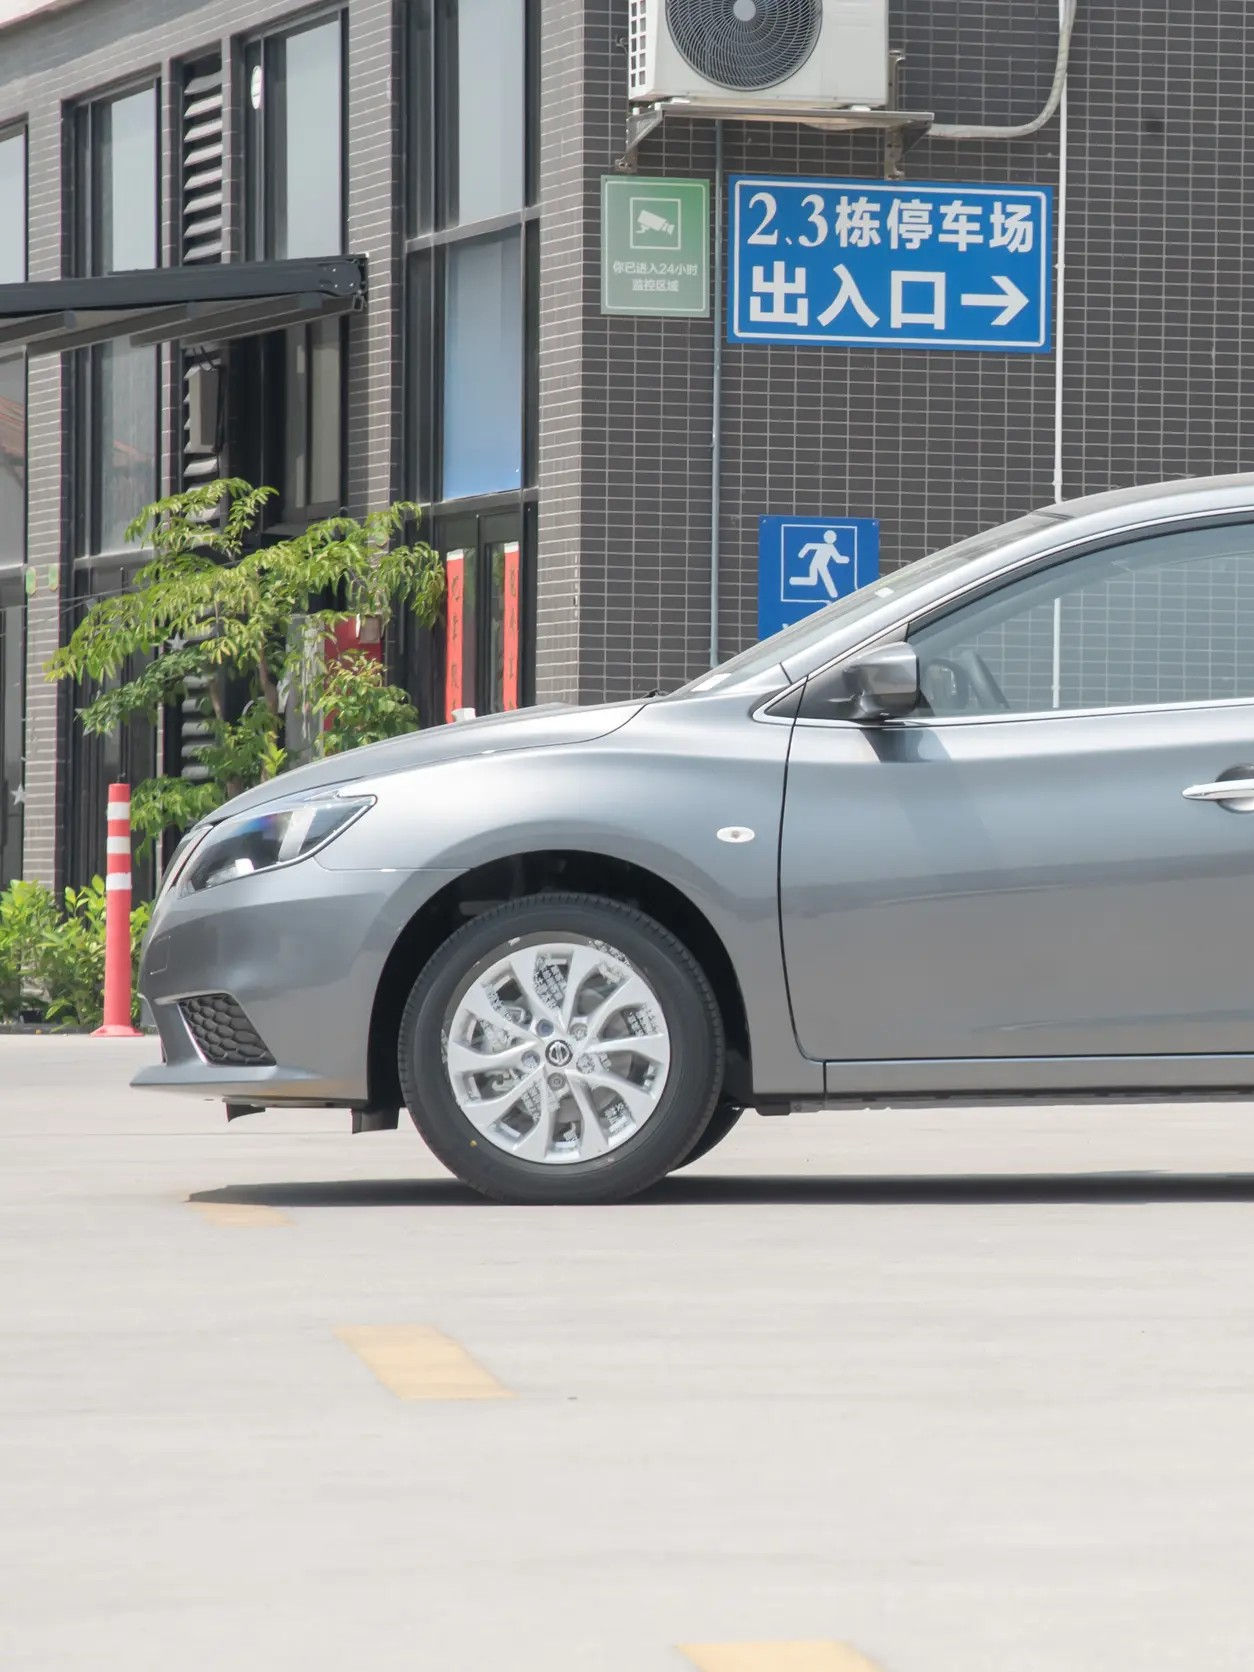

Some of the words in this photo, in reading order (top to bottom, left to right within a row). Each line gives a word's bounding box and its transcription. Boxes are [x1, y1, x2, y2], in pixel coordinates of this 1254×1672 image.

[631, 278, 680, 292] 监控区域
[749, 260, 947, 331] 出入口
